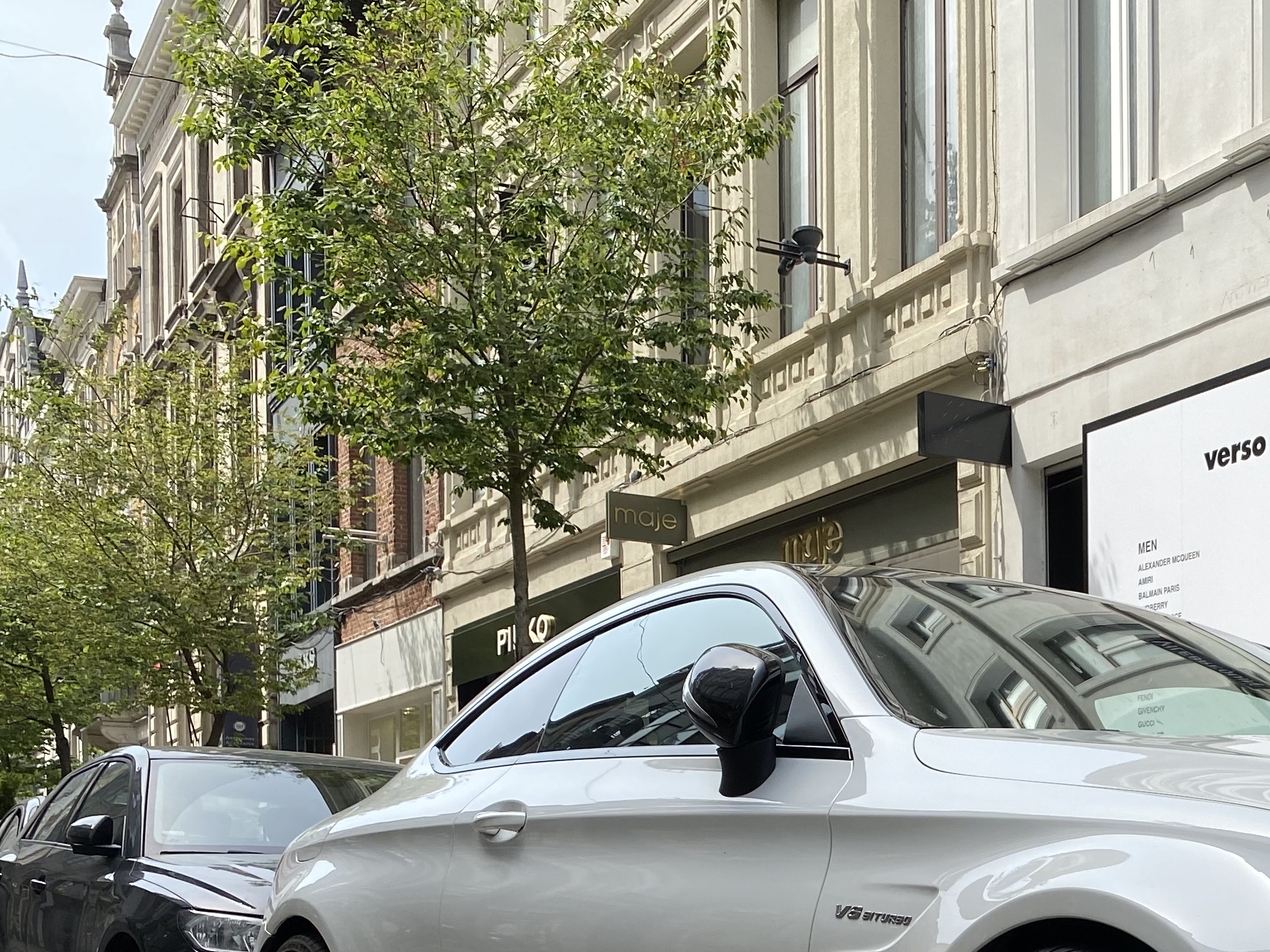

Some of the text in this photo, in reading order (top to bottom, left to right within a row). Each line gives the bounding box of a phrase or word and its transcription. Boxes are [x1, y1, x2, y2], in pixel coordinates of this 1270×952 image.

[1204, 435, 1267, 471] verso
[614, 506, 677, 532] maje
[1138, 539, 1158, 554] MEN
[1138, 550, 1201, 572] ALEXANDER MCQUEEN
[1138, 575, 1154, 586] AMIRI
[1138, 583, 1180, 600] BALMAIN PARIS
[1137, 693, 1154, 702] FENDI
[1137, 705, 1166, 716] GIVENCHY
[1137, 720, 1156, 729] GUCCI
[861, 911, 912, 926] BITURBO
